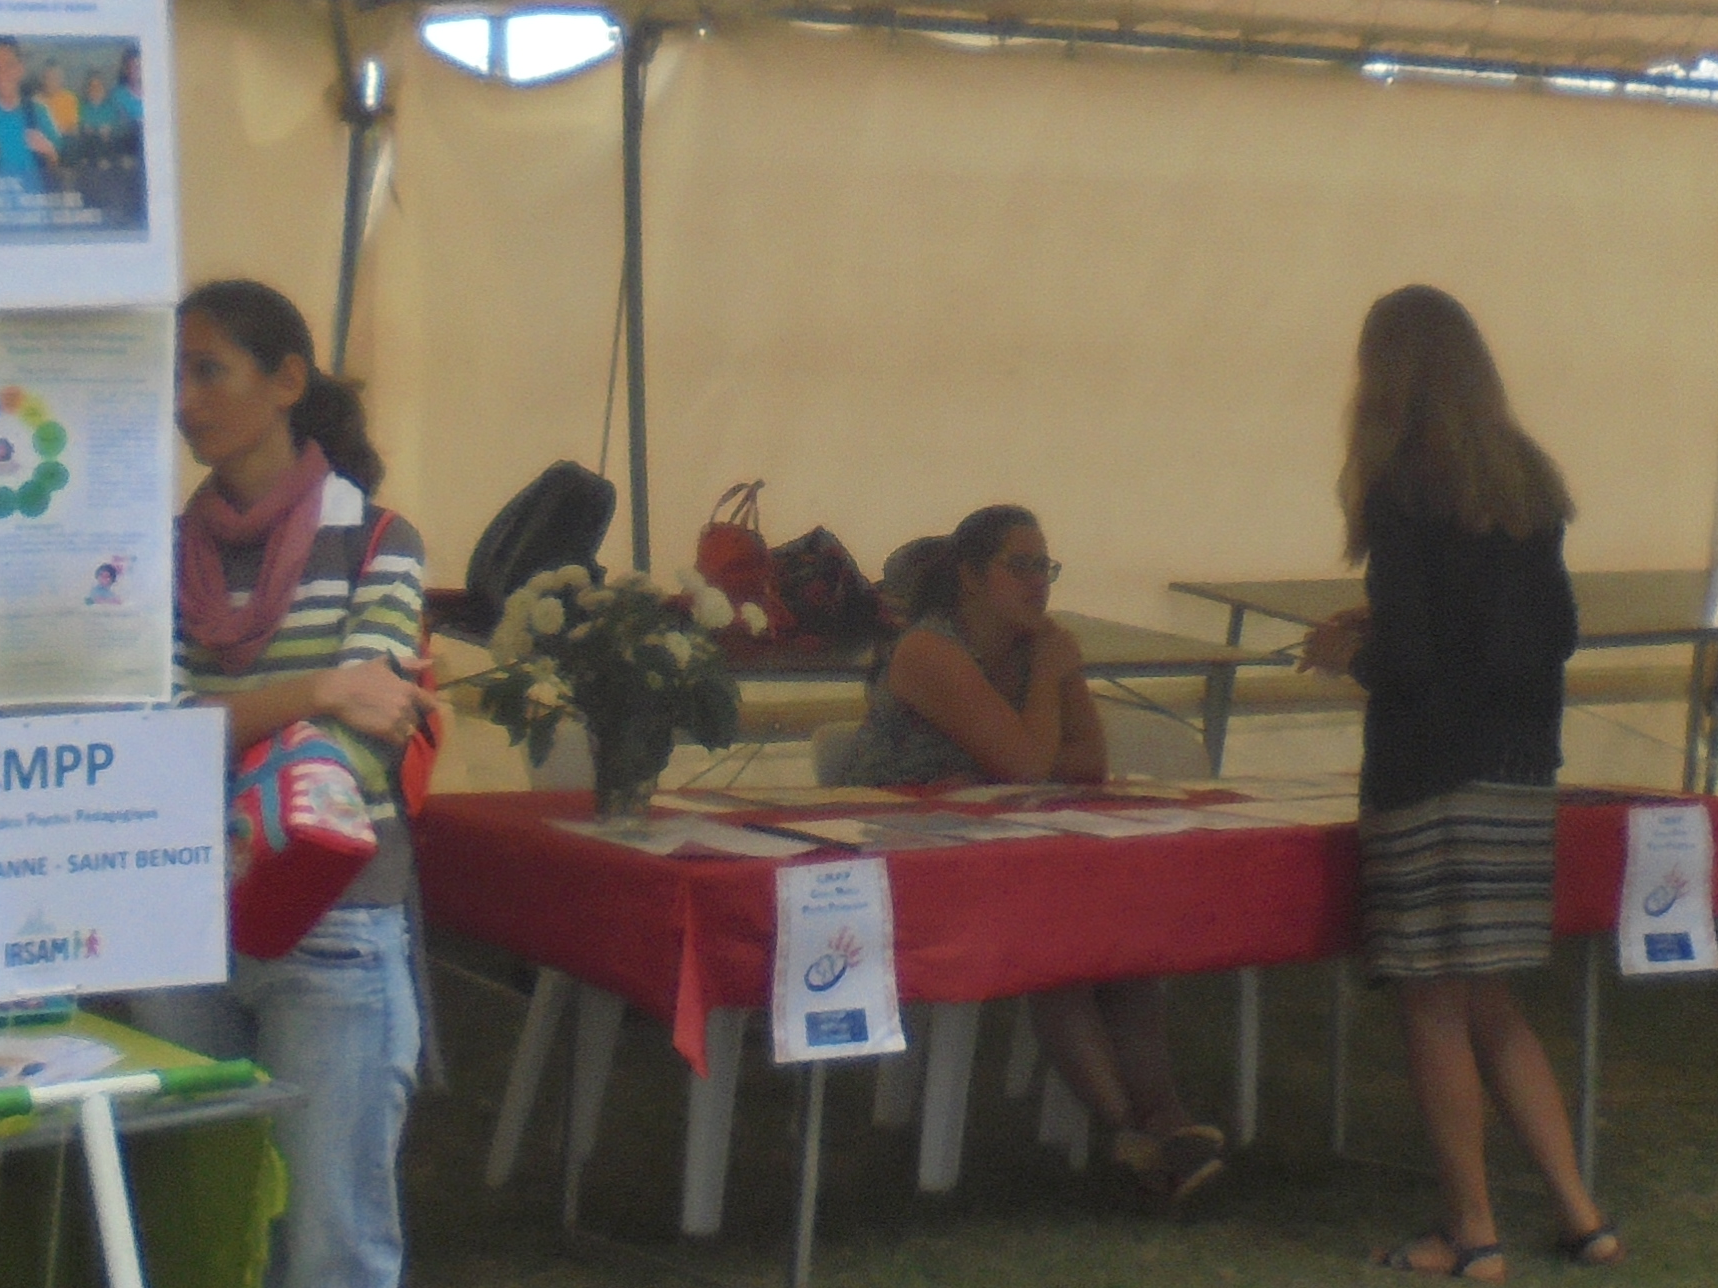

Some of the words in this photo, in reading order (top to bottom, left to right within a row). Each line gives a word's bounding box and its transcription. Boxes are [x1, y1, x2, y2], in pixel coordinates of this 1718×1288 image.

[68, 851, 128, 874] SAINT
[135, 846, 212, 869] BENOIT
[3, 937, 70, 968] IRSAM
